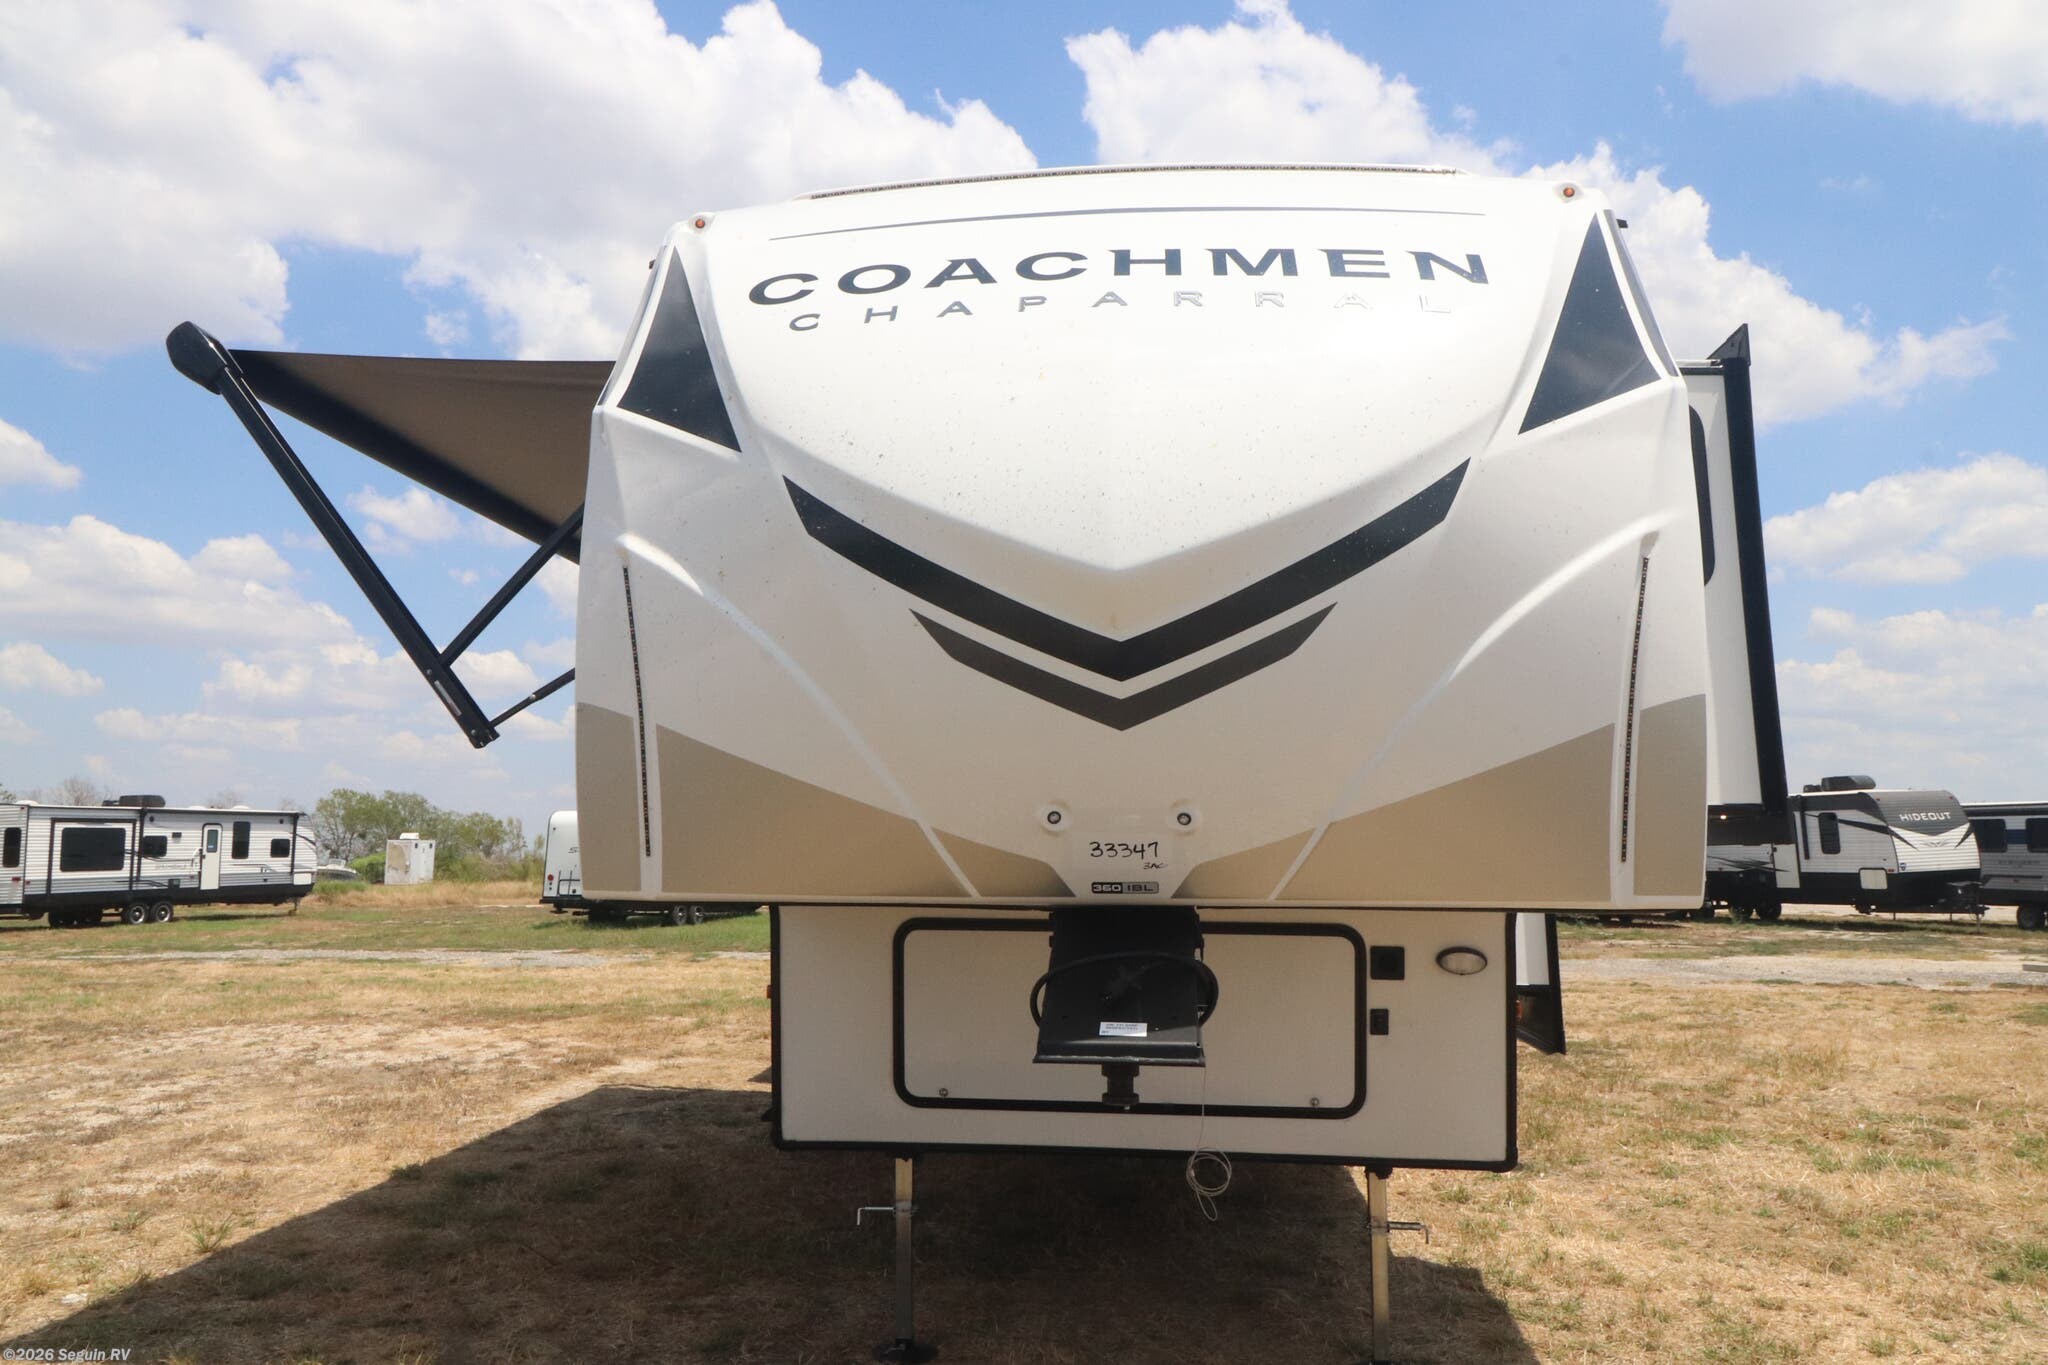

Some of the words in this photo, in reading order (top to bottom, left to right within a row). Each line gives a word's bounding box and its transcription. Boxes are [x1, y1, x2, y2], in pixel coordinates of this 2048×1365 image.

[749, 248, 1489, 305] COACHMEN
[789, 290, 1452, 331] CHAPARRAL
[1899, 811, 1952, 822] HIDEOUT
[1089, 841, 1158, 860] 33347
